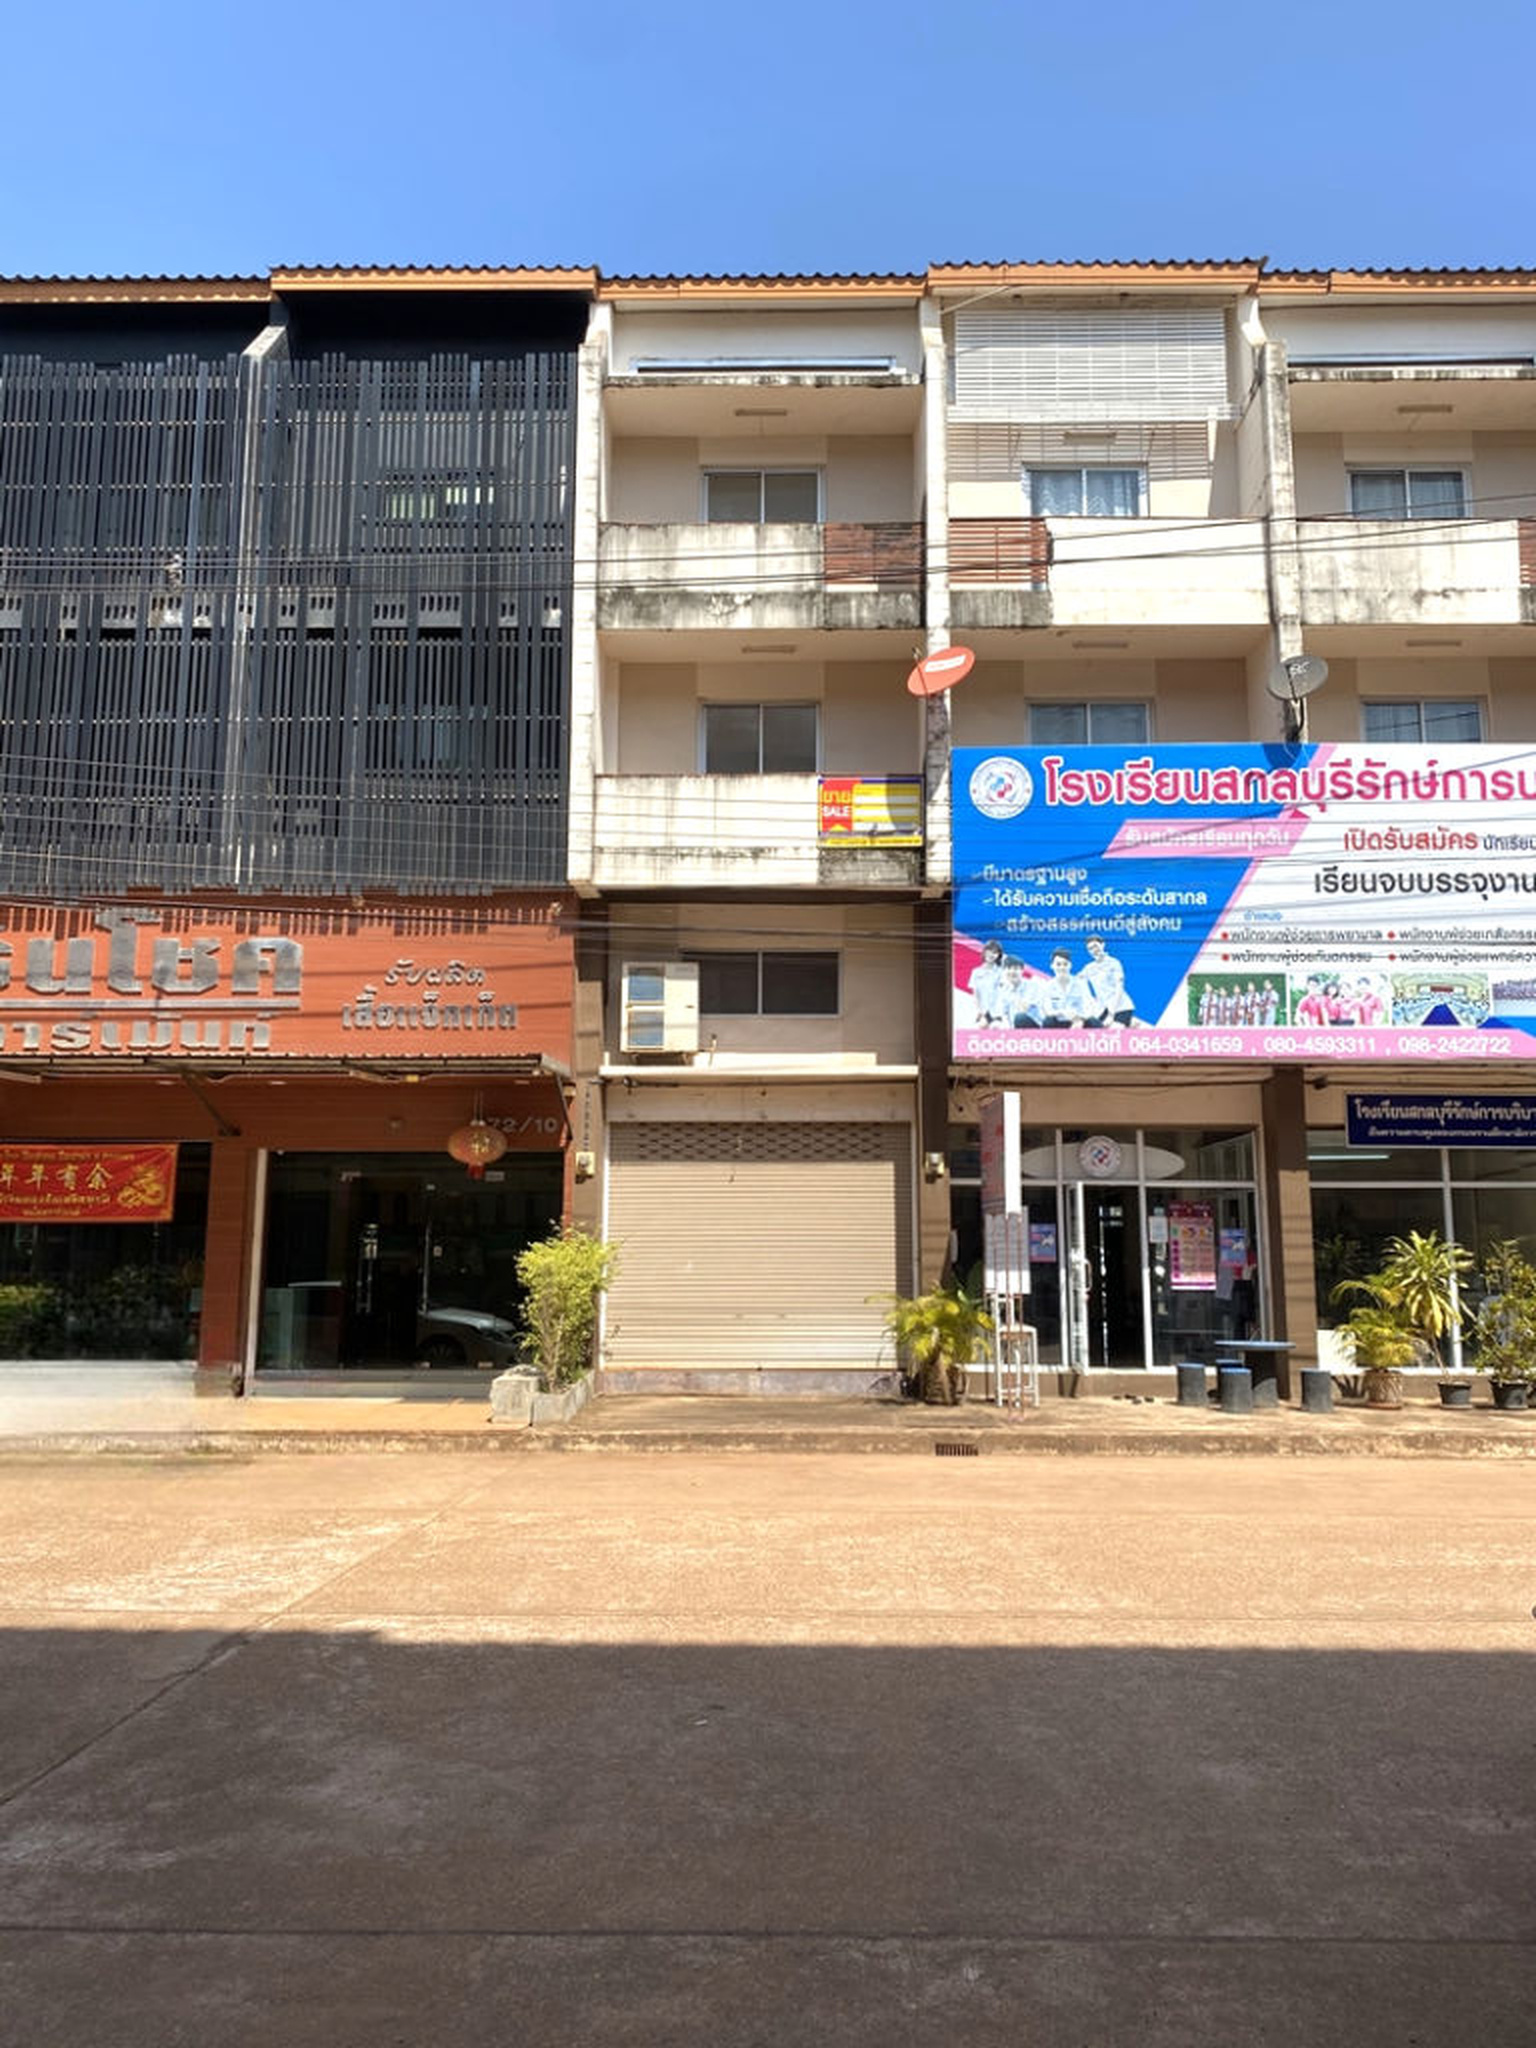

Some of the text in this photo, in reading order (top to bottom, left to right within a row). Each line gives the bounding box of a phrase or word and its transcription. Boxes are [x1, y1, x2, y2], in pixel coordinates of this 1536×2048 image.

[823, 805, 850, 817] SALE
[1344, 826, 1478, 851] เปิดรับสมัคร
[983, 864, 1087, 886] มีมาตรฐานสูง
[1314, 866, 1536, 901] เรียนจบบรรจุงาน
[992, 887, 1207, 906] ได้รับความเชื่อถือระดับสากล
[1007, 914, 1182, 936] สร้างสรรค์คนดีสู่สังคม
[0, 907, 302, 995] นโชค
[384, 959, 486, 986] รับผลิต
[0, 1010, 270, 1050] าร์เม้นท์
[967, 1032, 1121, 1053] ติดต่อสอบถามได้ที่
[1129, 1036, 1243, 1053] 064-0341659
[1262, 1036, 1376, 1053] 080-4593311
[1398, 1036, 1512, 1053] 098-2422722
